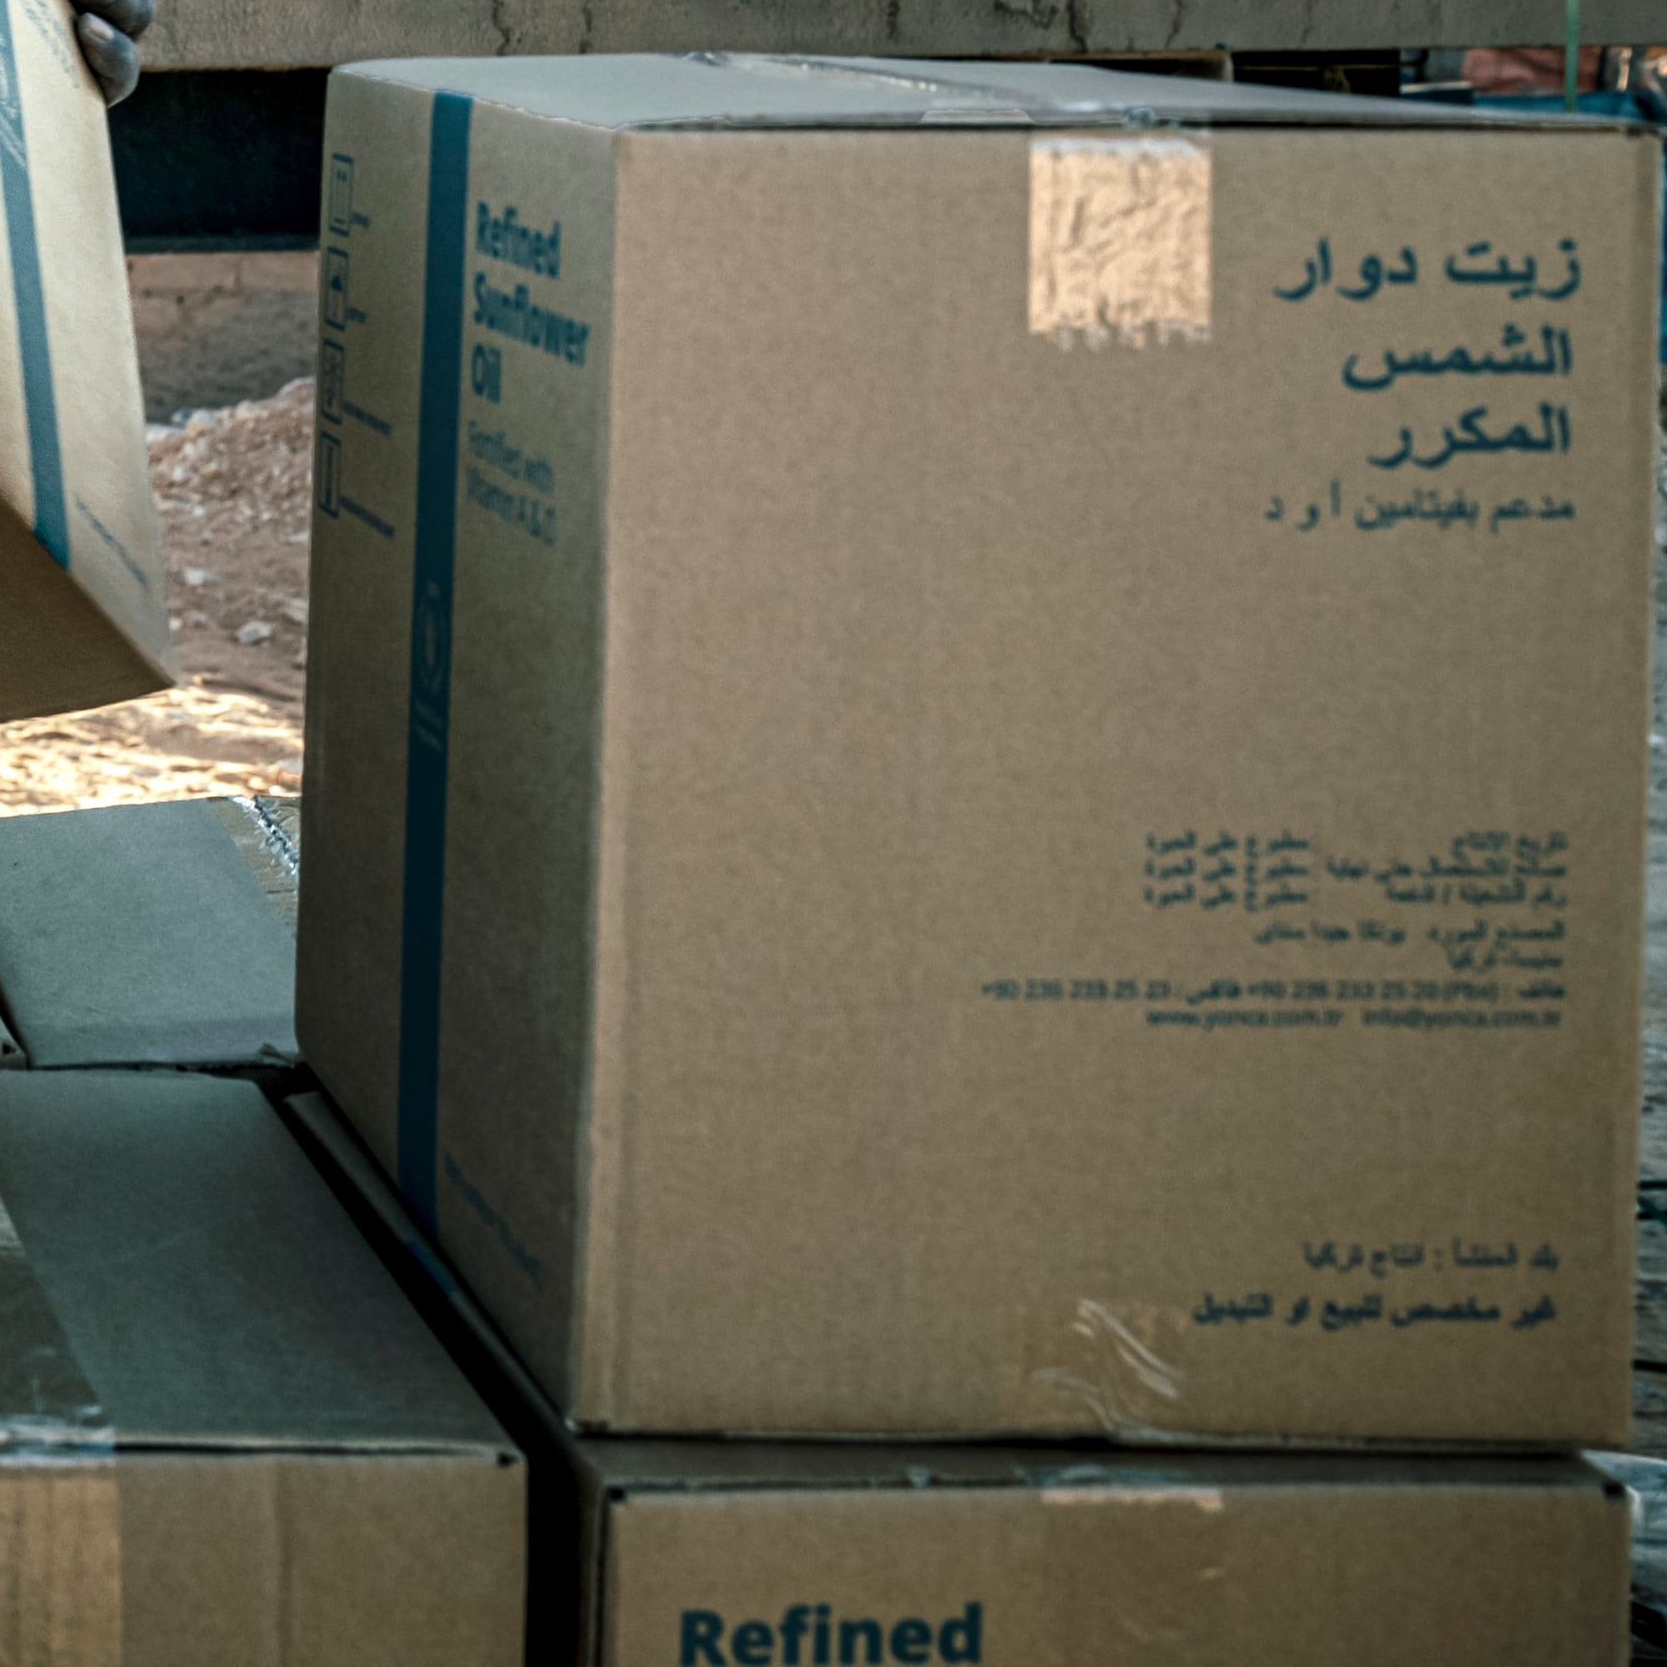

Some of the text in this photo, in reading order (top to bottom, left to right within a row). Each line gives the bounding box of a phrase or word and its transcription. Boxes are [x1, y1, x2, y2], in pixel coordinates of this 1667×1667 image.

[476, 201, 561, 279] Refined
[1273, 236, 1582, 302] زيت دوار
[473, 272, 591, 368] Sunflower
[1341, 322, 1573, 393] الشمس
[1366, 400, 1572, 471] المكرر
[679, 1600, 984, 1667] Refined
